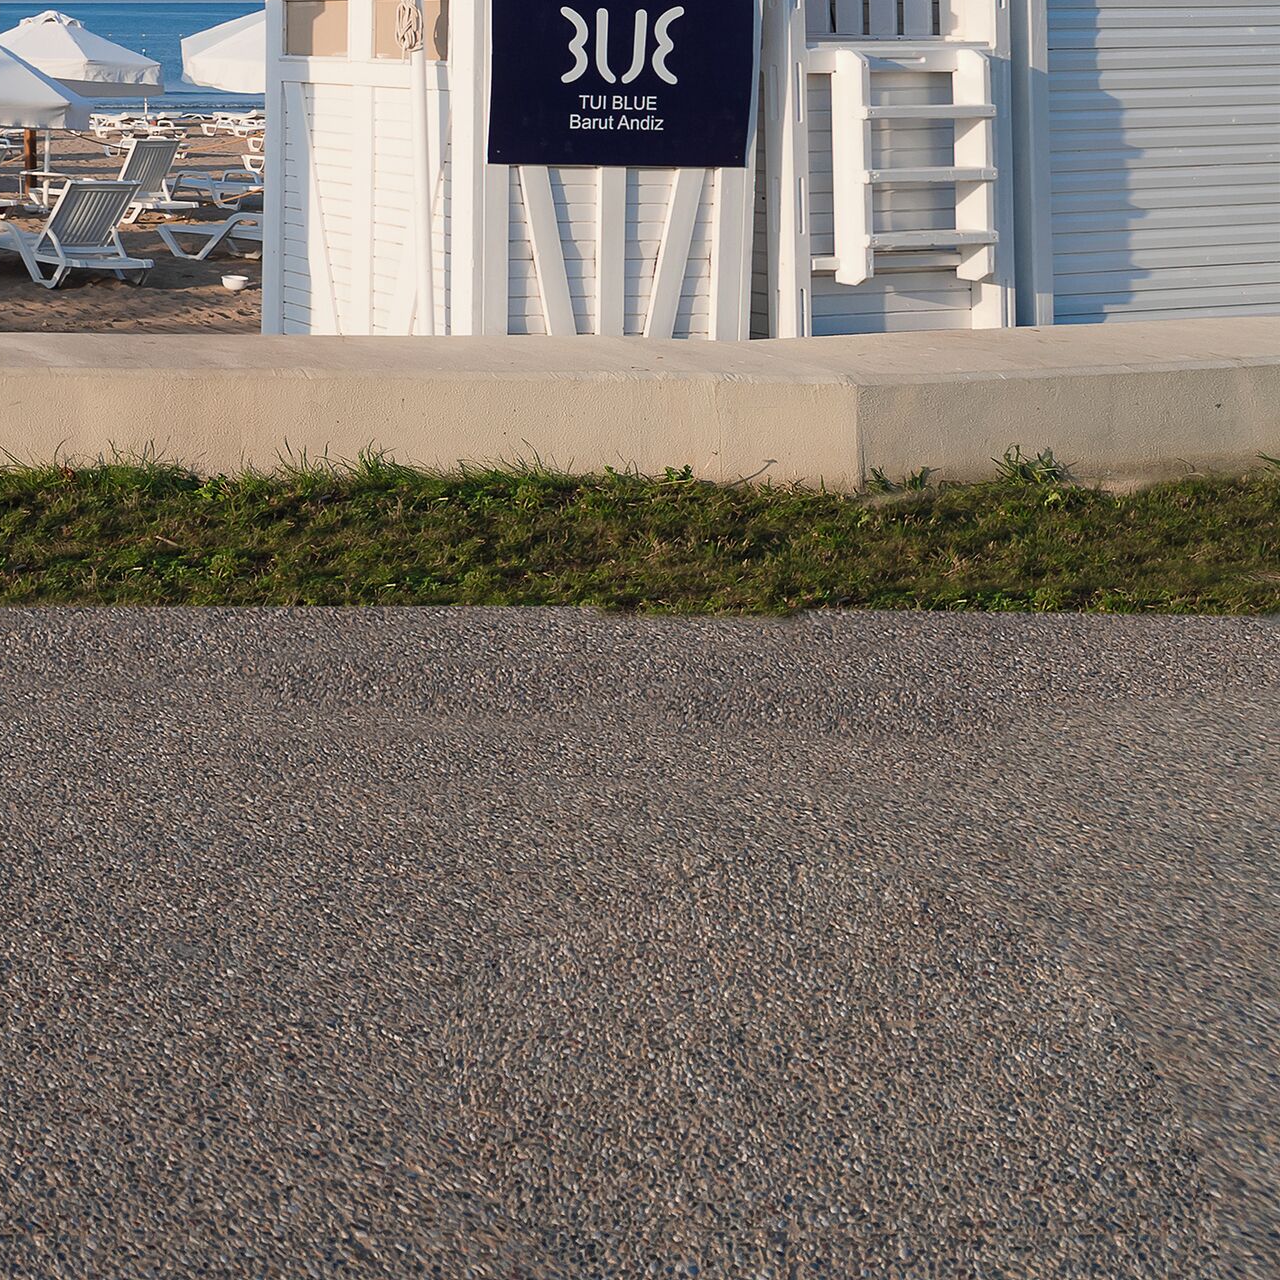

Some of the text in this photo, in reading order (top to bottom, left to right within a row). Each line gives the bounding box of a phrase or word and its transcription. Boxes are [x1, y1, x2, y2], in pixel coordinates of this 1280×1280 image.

[578, 94, 658, 111] TUI BLUE
[569, 113, 664, 131] Barut Andiz
